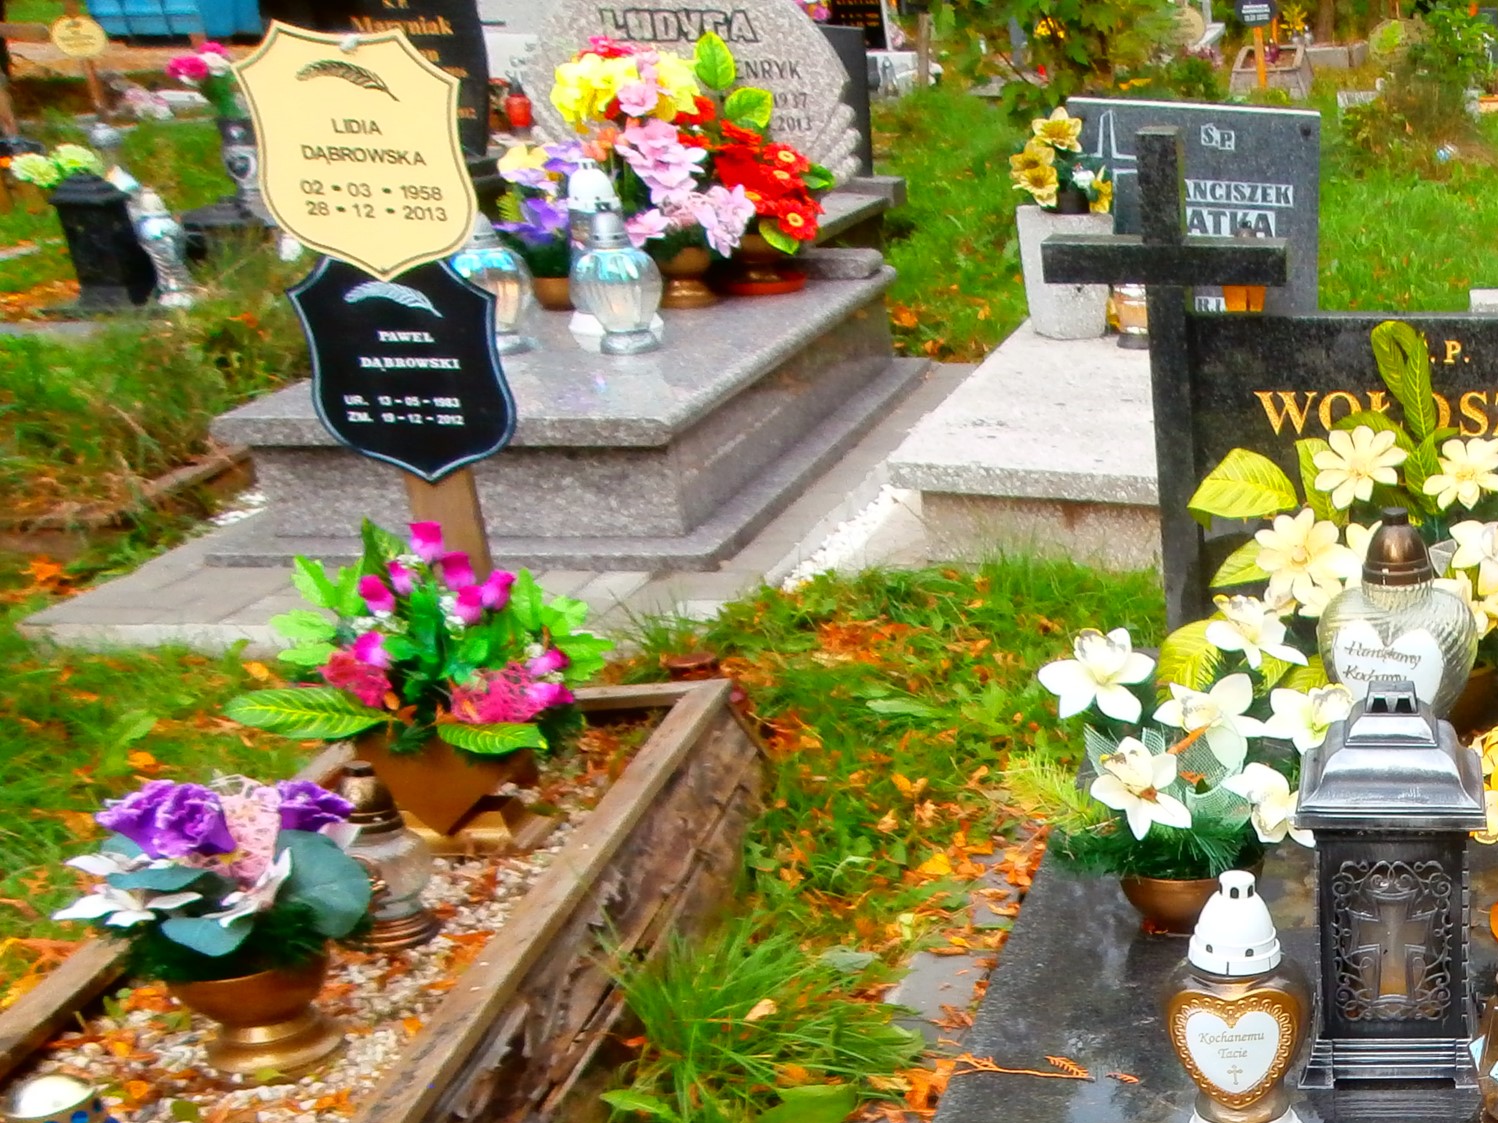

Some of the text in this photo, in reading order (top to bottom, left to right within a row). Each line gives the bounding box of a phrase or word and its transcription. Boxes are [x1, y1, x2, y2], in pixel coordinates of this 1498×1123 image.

[331, 118, 382, 135] LIDIA
[301, 144, 427, 166] DĄBROWSKA
[300, 180, 443, 201] 02 03 1958
[306, 202, 447, 221] 28 12 2013
[359, 356, 462, 372] DĄBROWSKI
[343, 394, 370, 406] UR.
[436, 414, 465, 425] 2012
[1198, 1030, 1265, 1045] Kochanemu
[1217, 1047, 1248, 1059] Tacie
